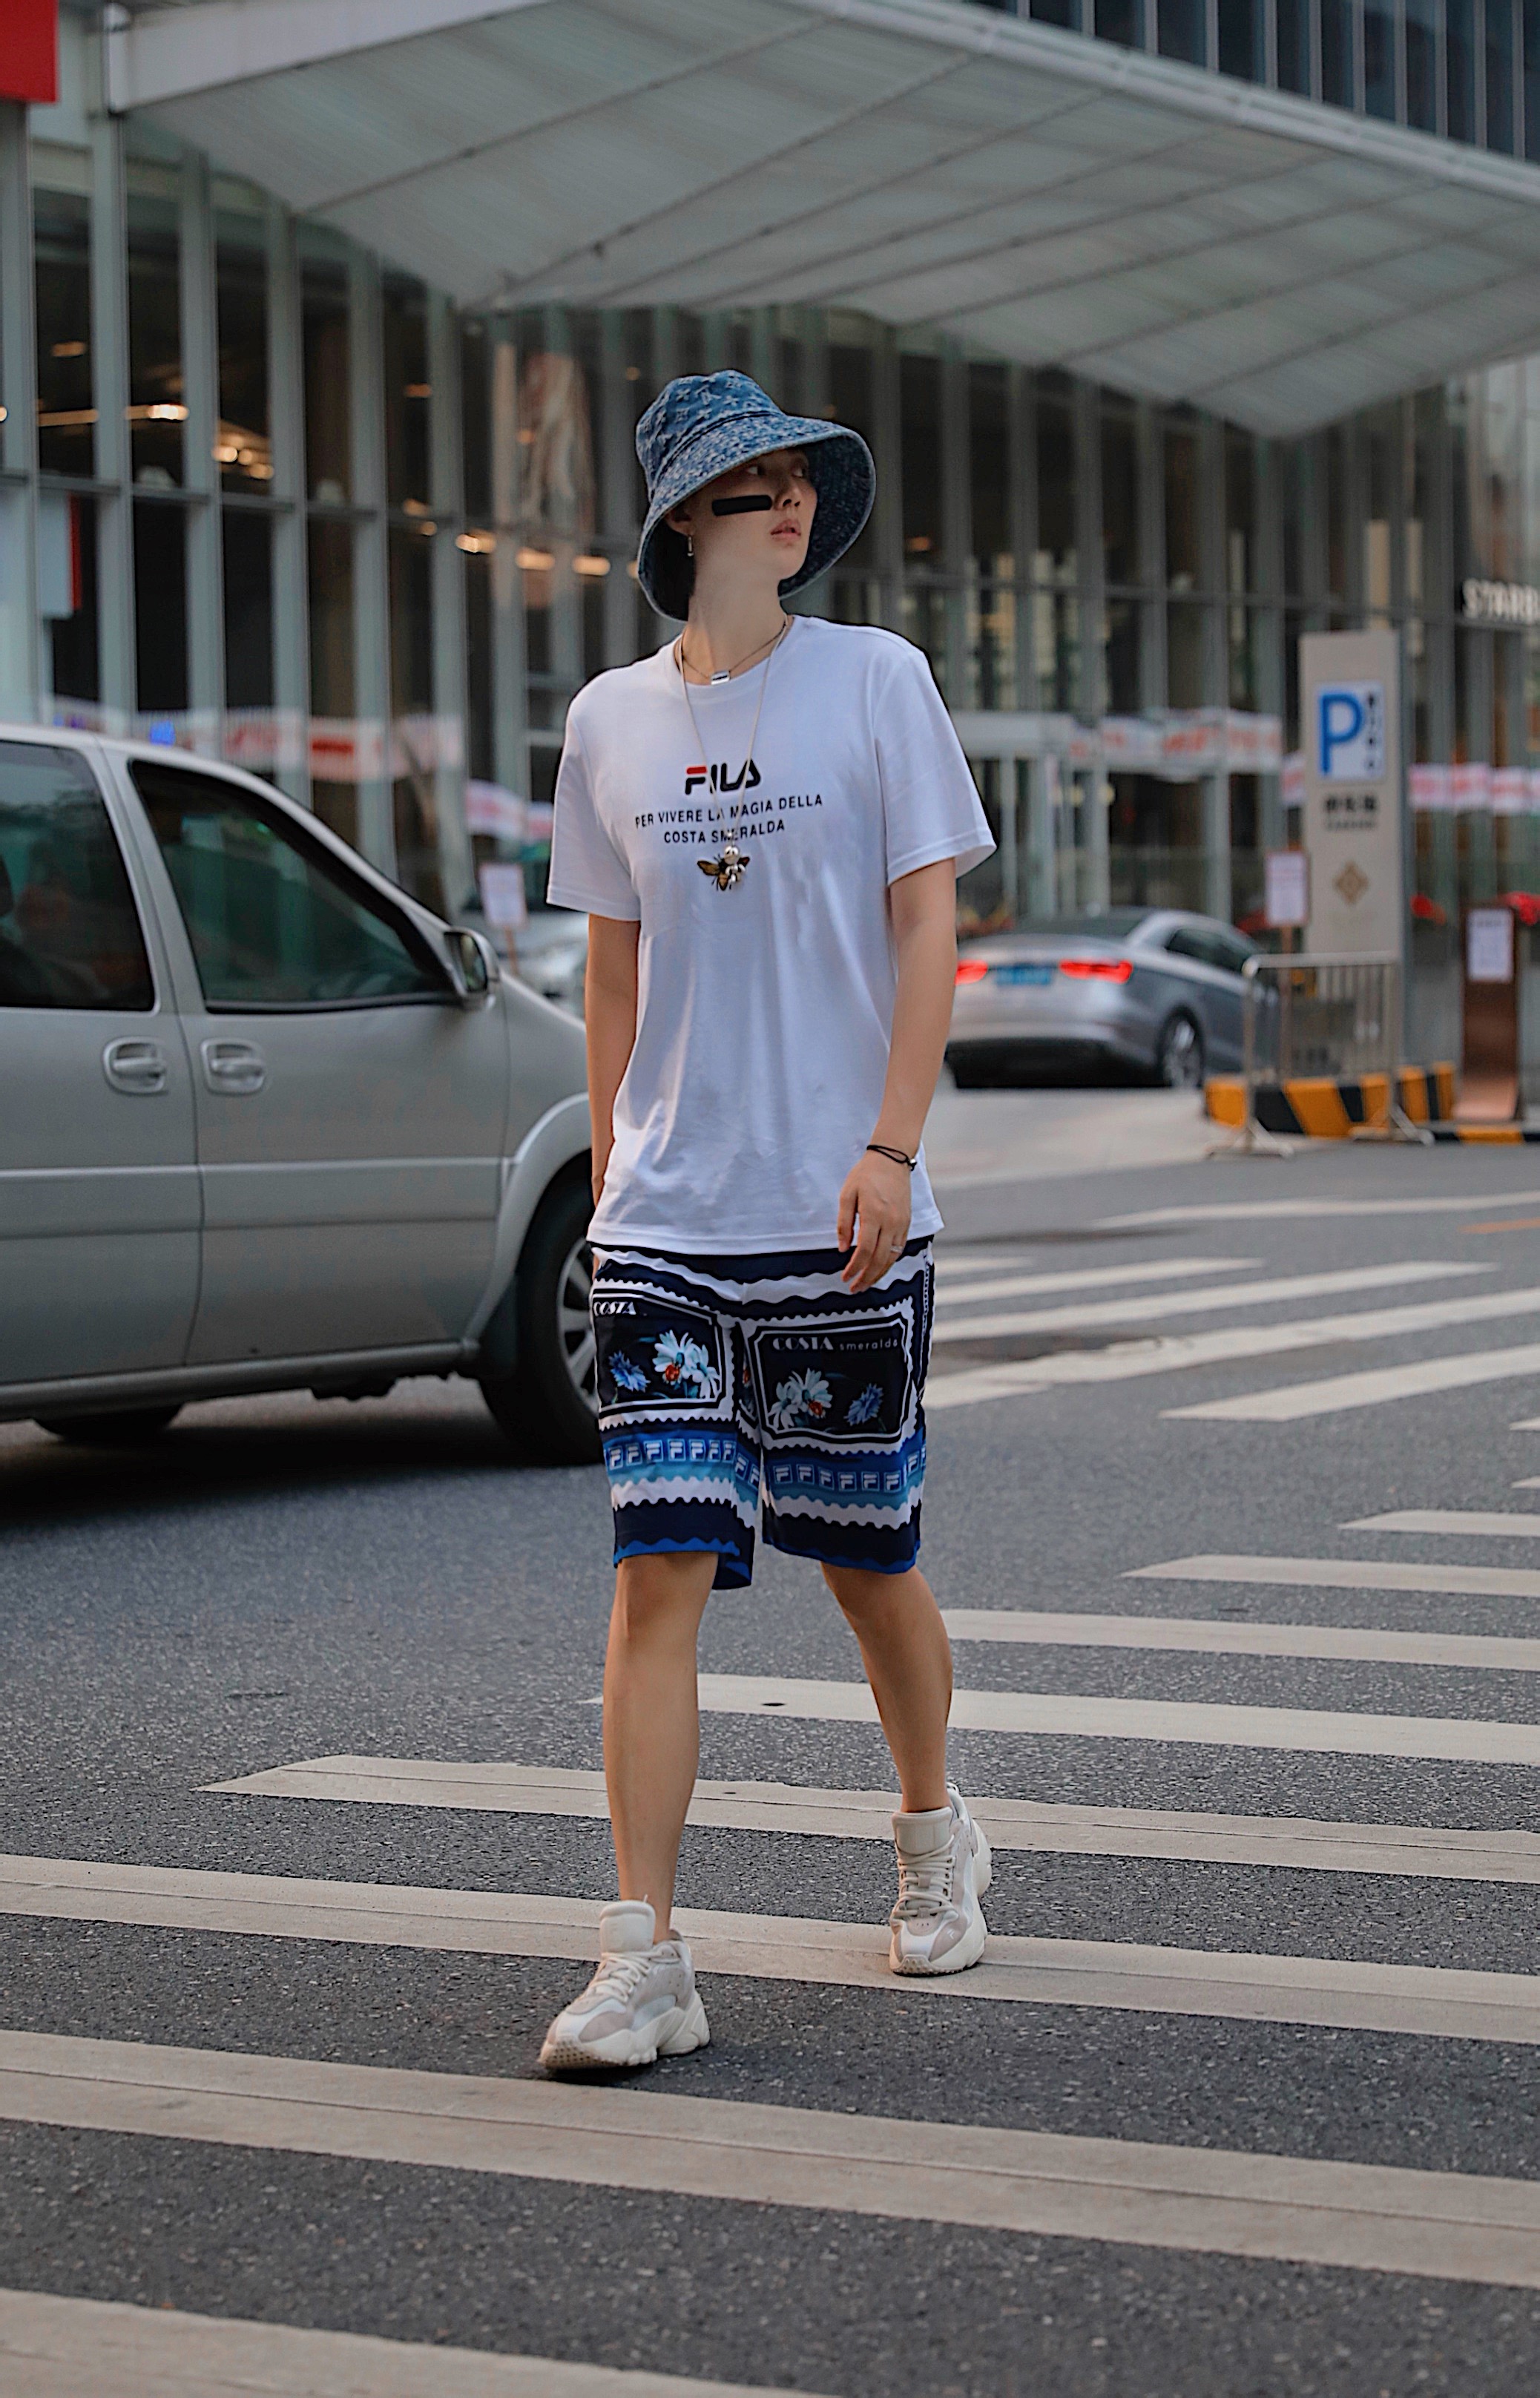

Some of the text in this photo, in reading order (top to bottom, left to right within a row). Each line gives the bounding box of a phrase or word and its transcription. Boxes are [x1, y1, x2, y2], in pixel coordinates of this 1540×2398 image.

[1319, 693, 1364, 774] P
[685, 758, 761, 795] FILA
[636, 812, 654, 829] PER
[658, 809, 702, 824] VIVERE
[730, 800, 773, 818] MAGIA
[779, 794, 823, 810] DELLA
[664, 831, 705, 844] COSTA
[593, 1301, 636, 1316] COSTA
[772, 1336, 834, 1350] COSTA
